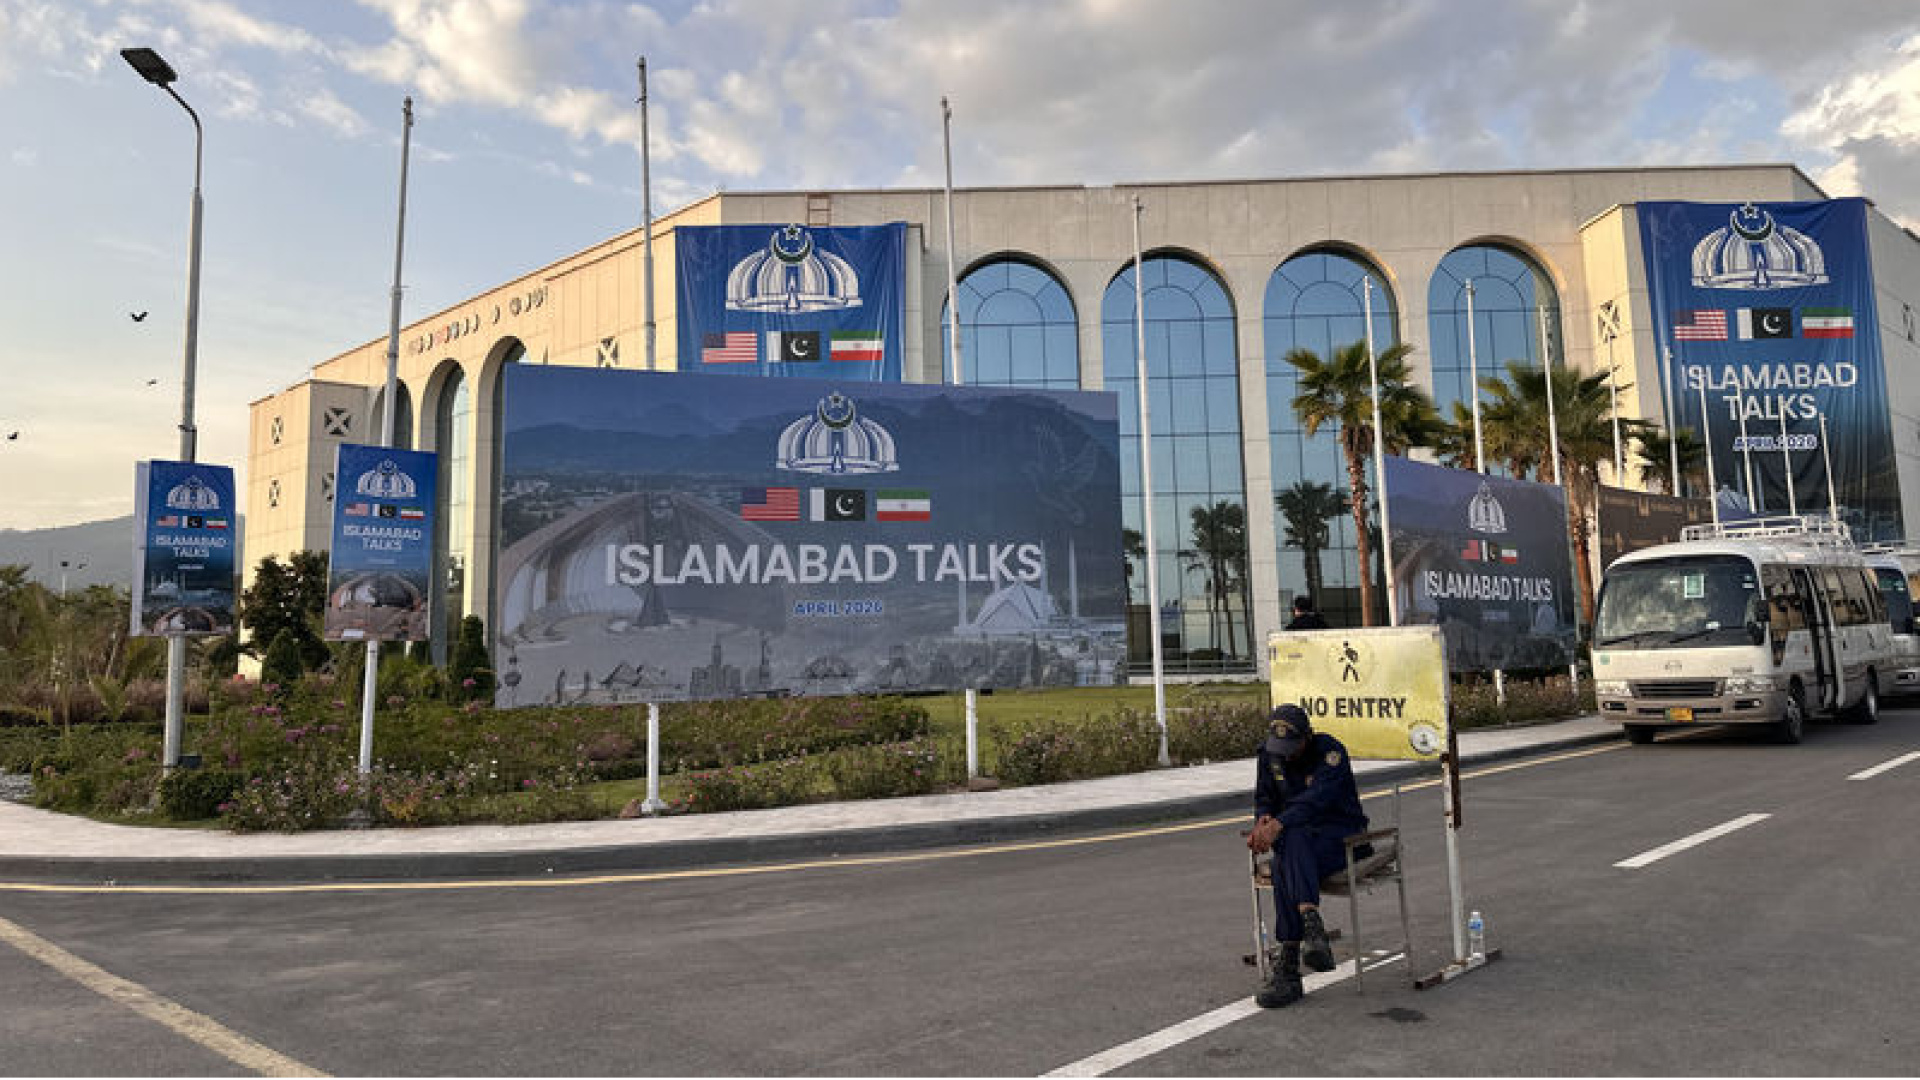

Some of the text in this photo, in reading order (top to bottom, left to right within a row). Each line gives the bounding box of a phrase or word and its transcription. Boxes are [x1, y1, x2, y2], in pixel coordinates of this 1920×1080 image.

[1682, 362, 1858, 390] ISLAMABAD
[1723, 394, 1818, 421] TALKS
[156, 535, 227, 547] ISLAMABAD
[343, 525, 421, 540] ISLAMABAD
[173, 546, 209, 557] TALKS
[363, 538, 402, 551] TALKS
[606, 543, 1042, 585] ISLAMABAD TALKS
[1424, 570, 1552, 601] ISLAMABAD TALKS
[794, 599, 883, 615] APRIL 2026
[1301, 697, 1407, 718] NO ENTRY
